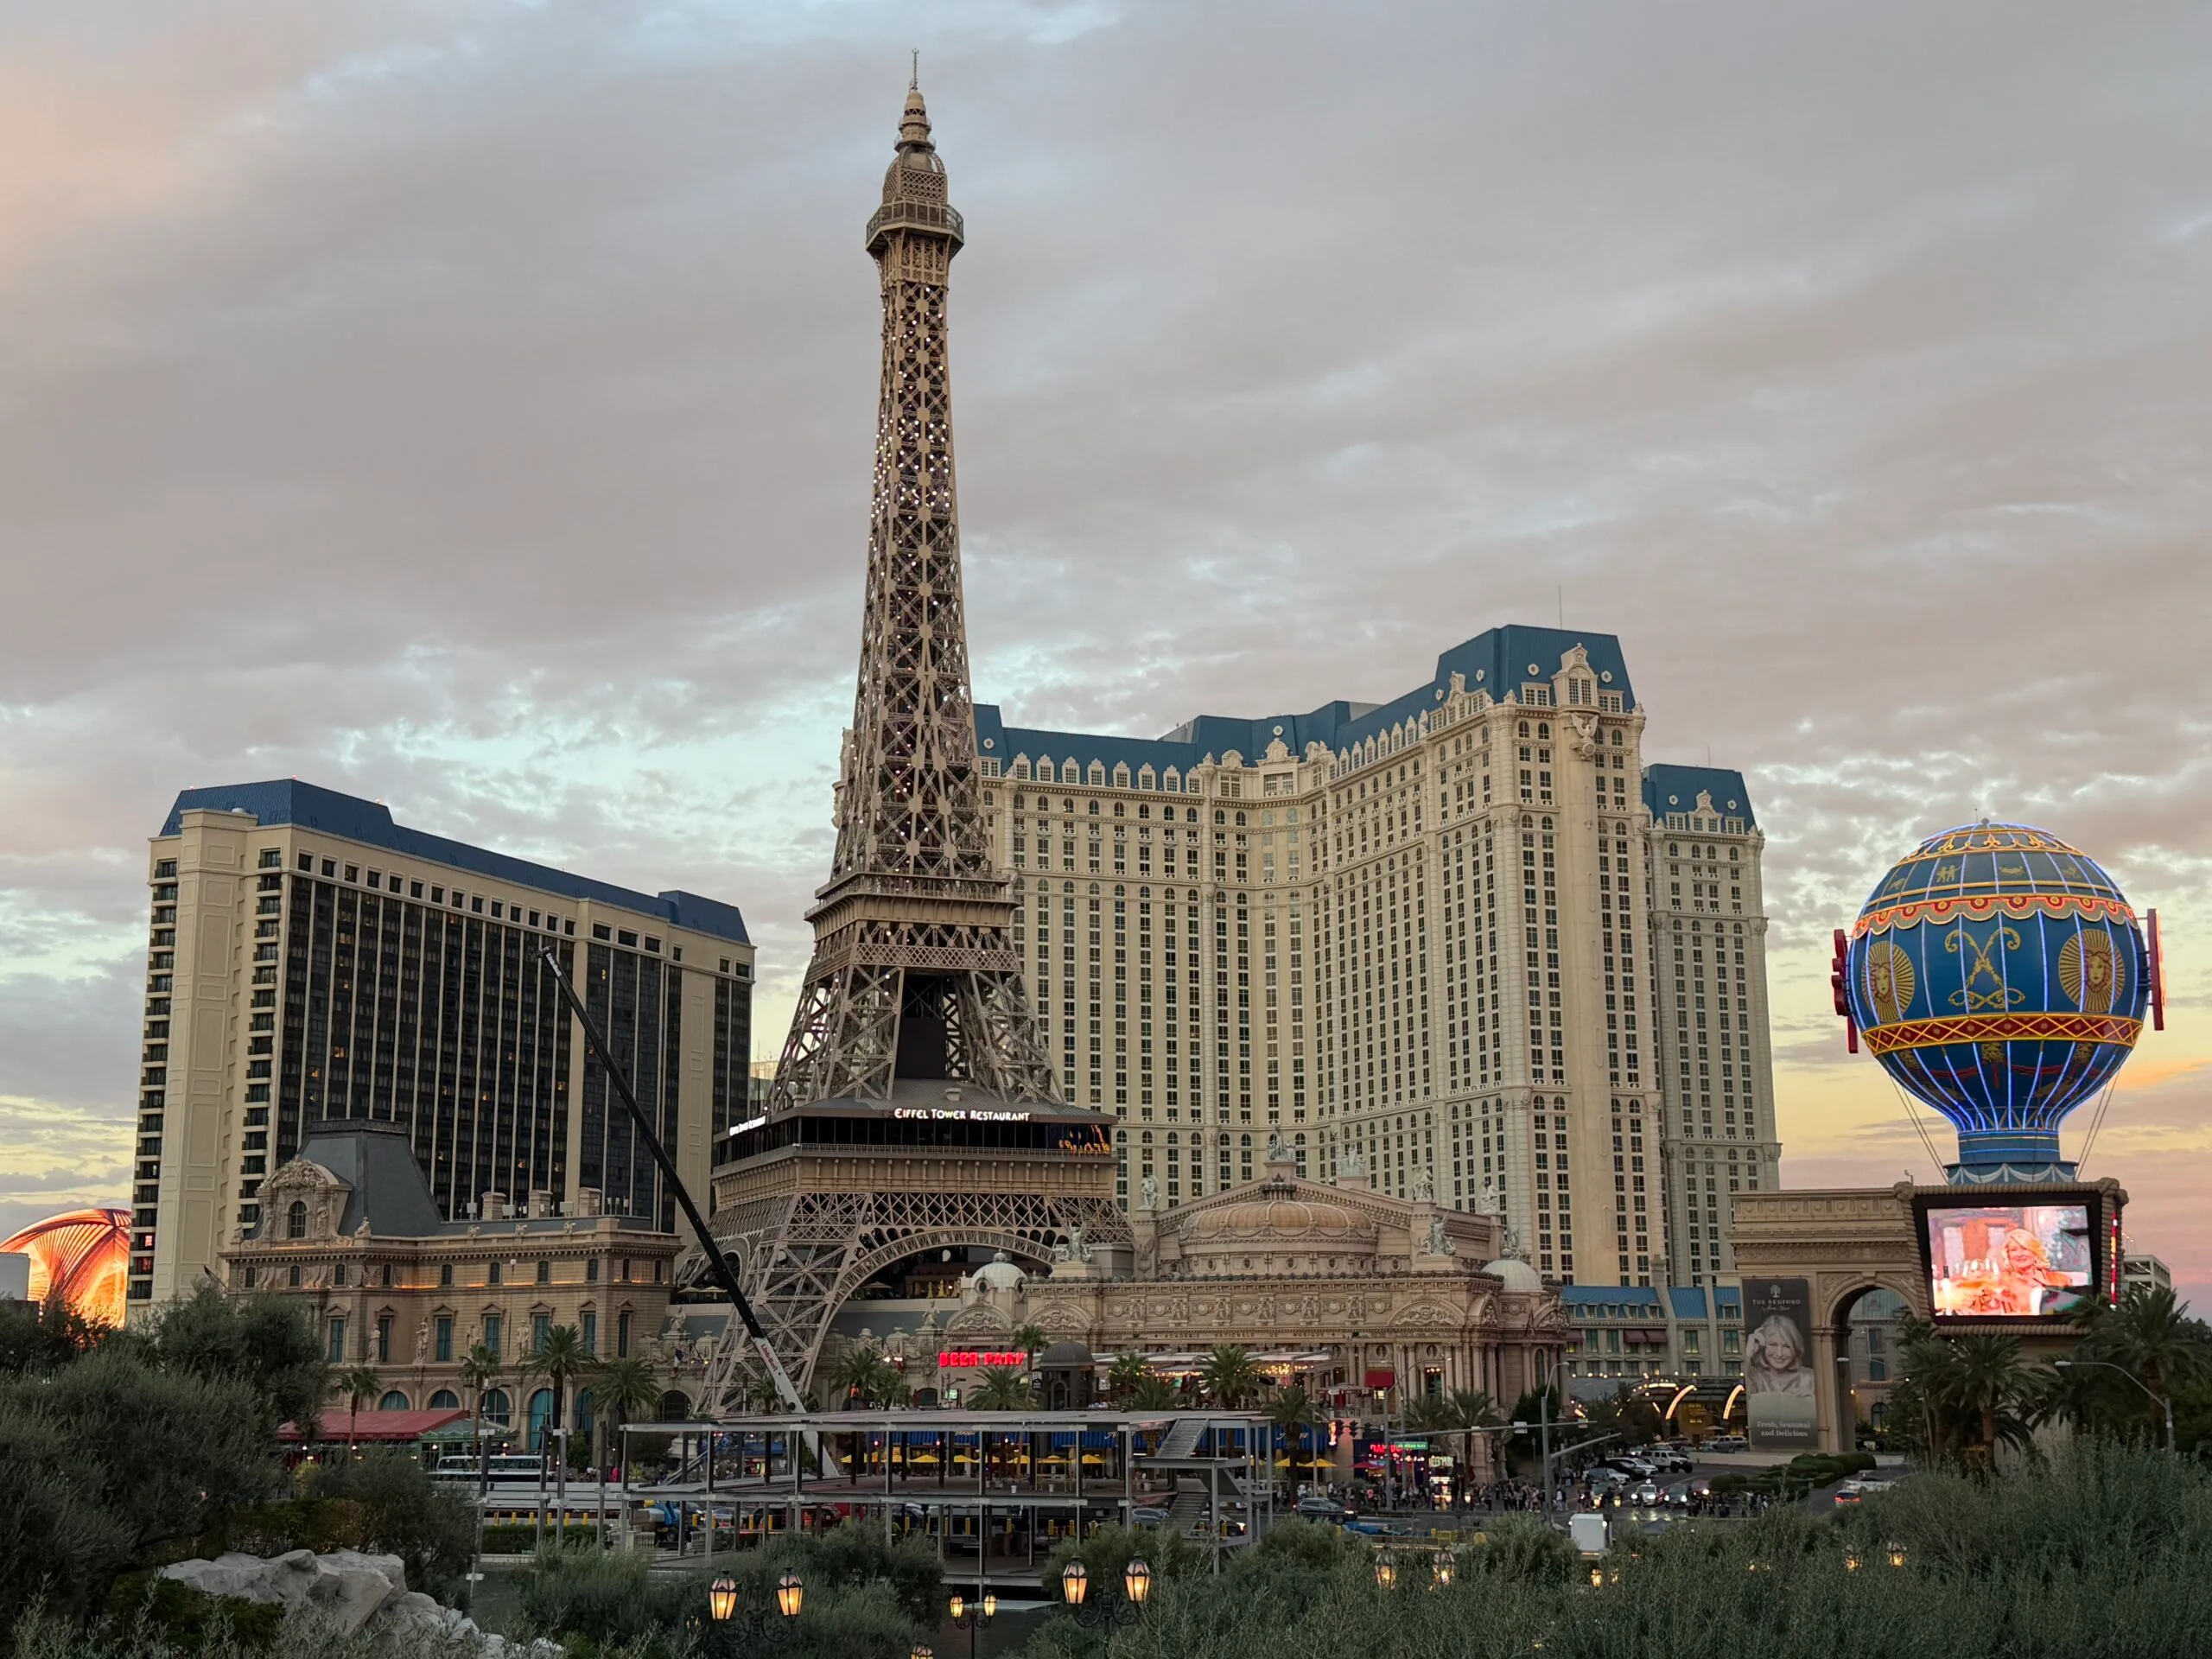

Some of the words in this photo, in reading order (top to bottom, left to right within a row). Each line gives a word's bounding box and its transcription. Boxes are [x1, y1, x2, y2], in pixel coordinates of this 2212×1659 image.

[931, 1109, 967, 1121] TOWER
[969, 1110, 1031, 1122] RESTAURANT
[938, 1351, 980, 1367] BEER
